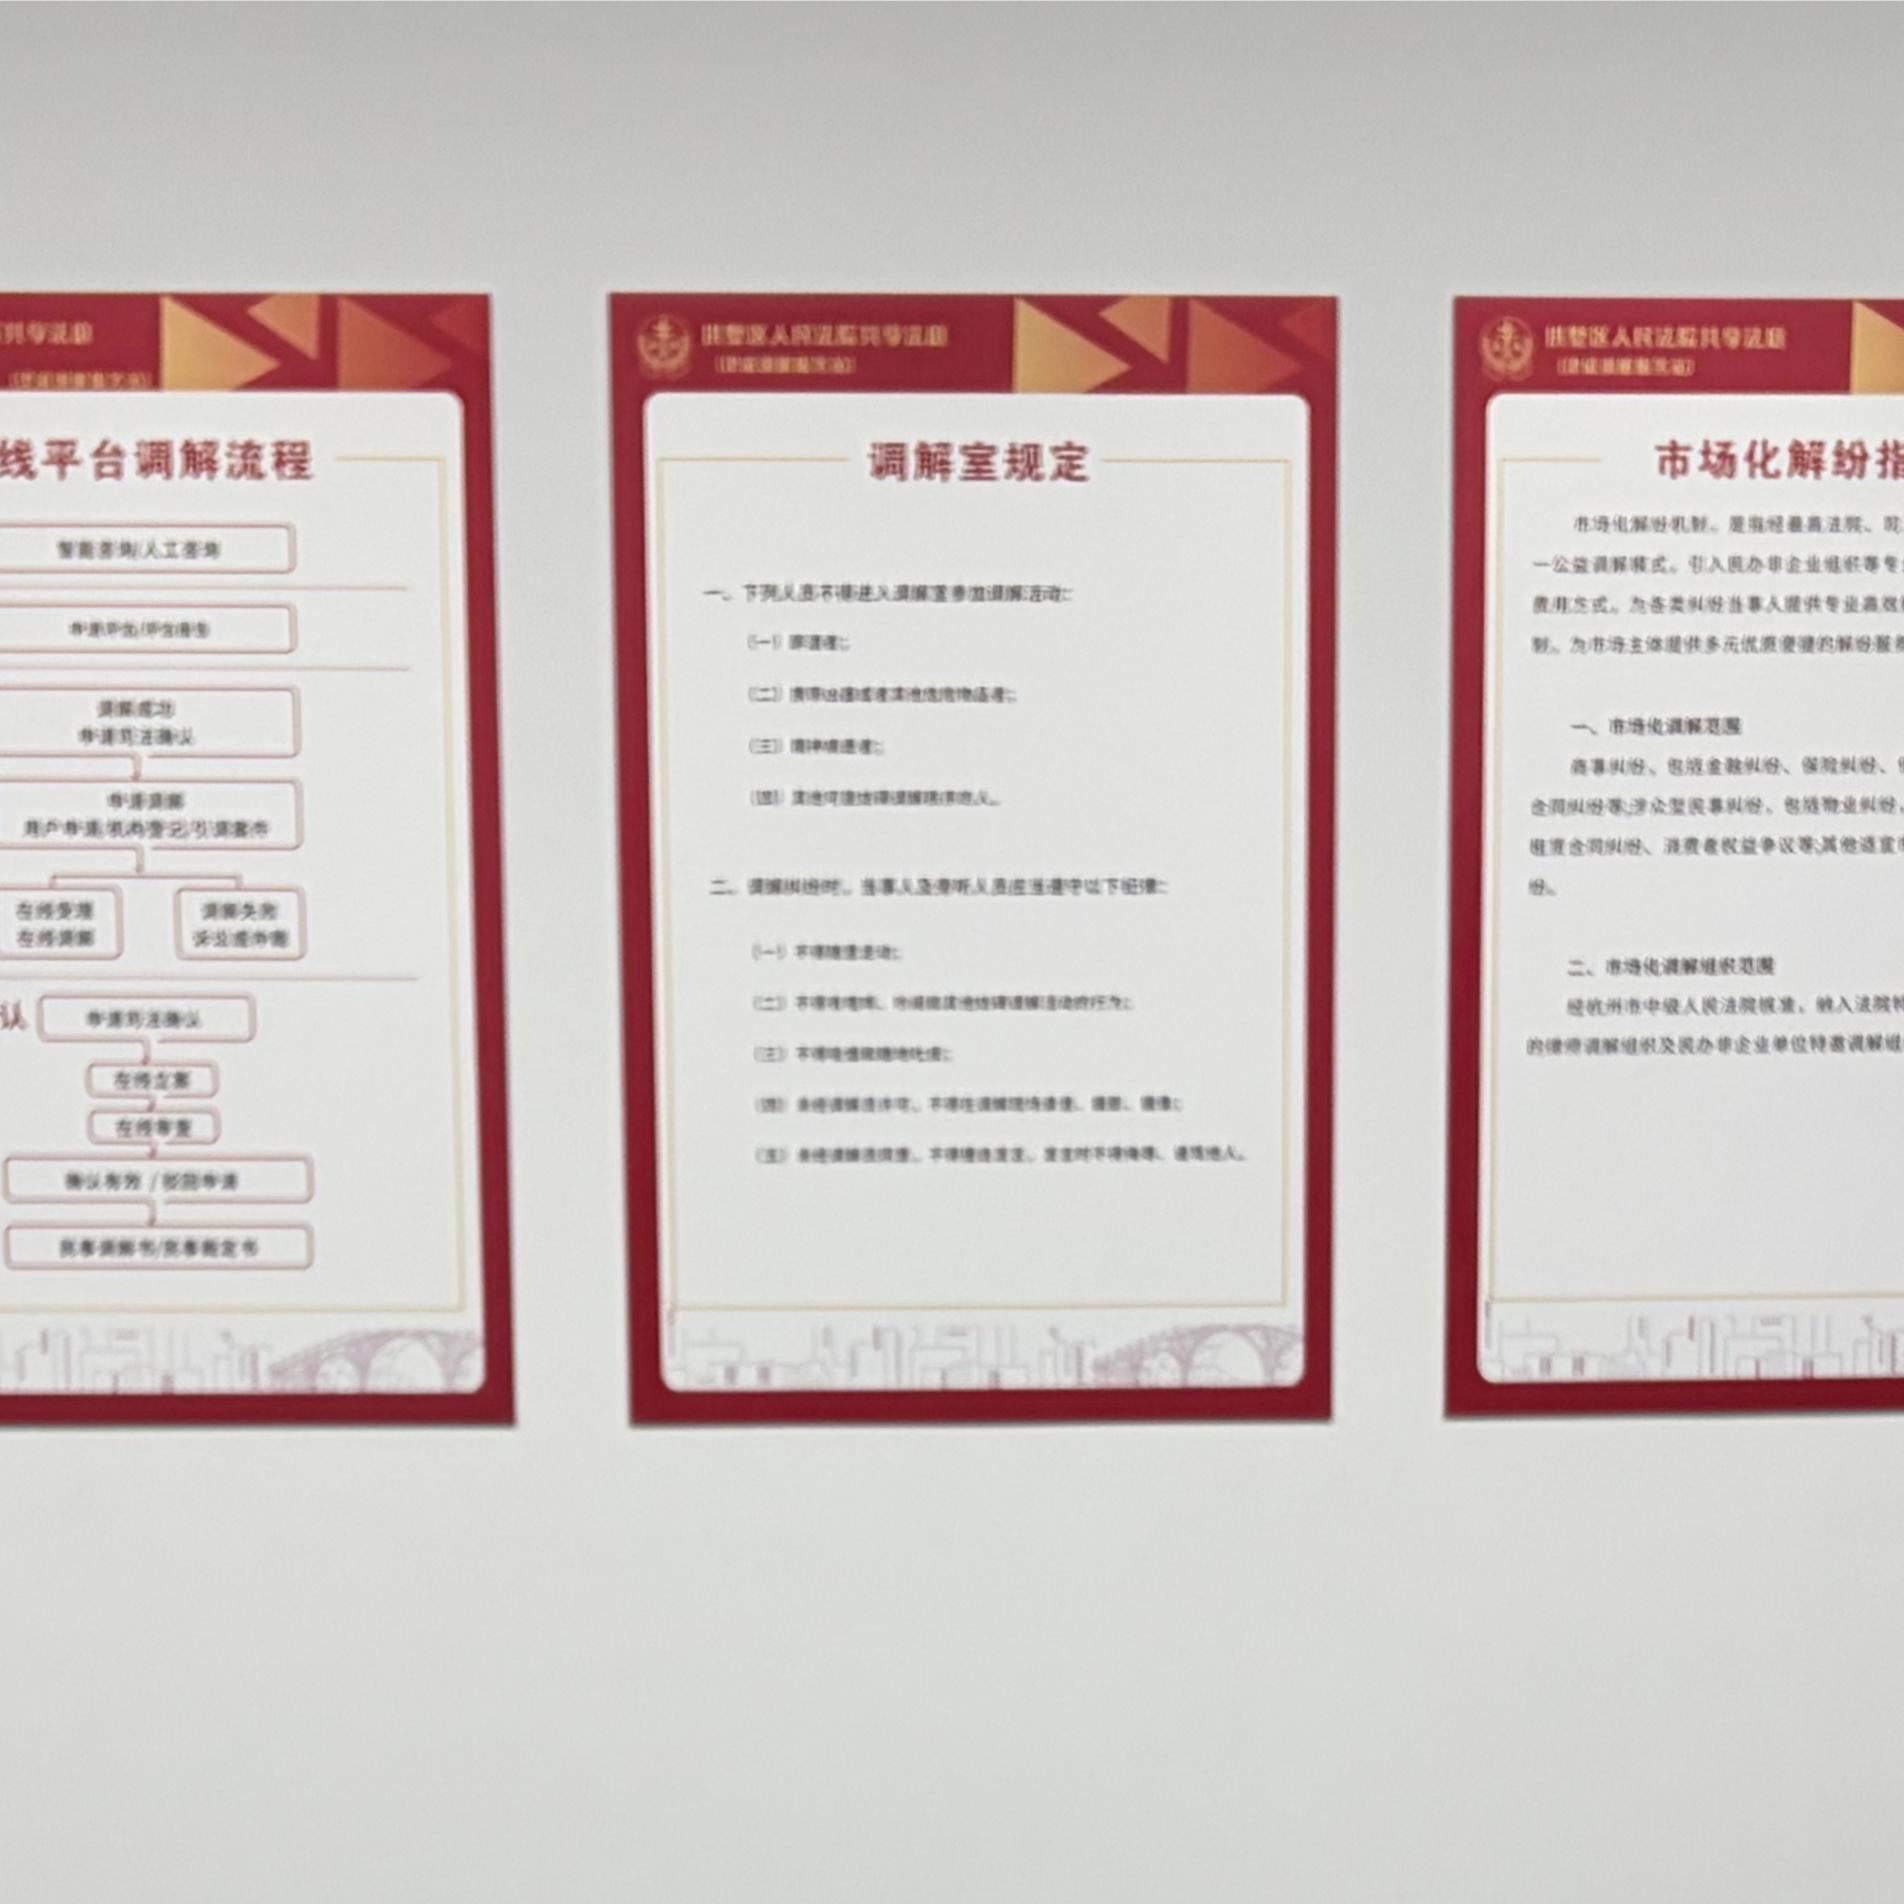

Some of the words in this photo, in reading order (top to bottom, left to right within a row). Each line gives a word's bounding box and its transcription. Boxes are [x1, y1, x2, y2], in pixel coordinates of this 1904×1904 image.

[869, 441, 1088, 482] 调解室规定
